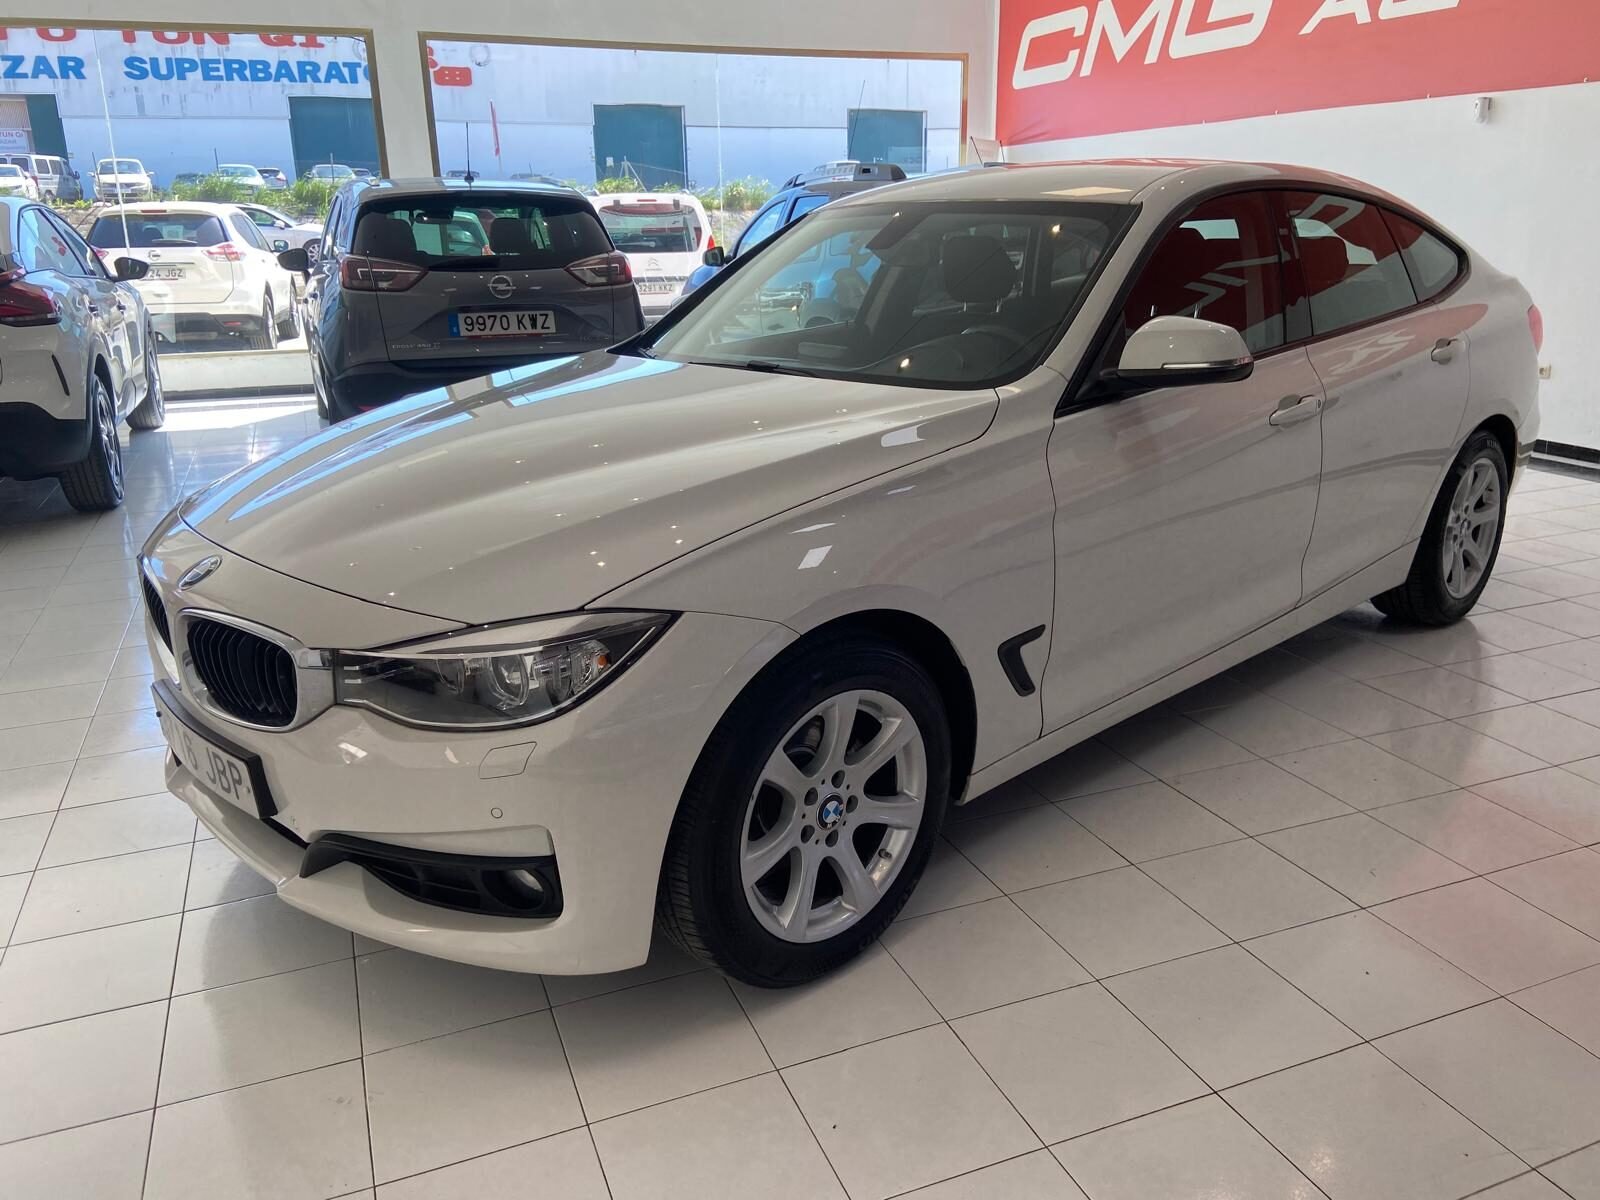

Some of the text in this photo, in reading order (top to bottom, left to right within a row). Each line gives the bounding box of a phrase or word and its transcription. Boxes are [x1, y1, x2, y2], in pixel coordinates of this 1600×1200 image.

[0, 54, 87, 80] ZAR
[149, 268, 161, 279] 24
[463, 313, 551, 333] 9970 KWZ
[205, 746, 243, 801] JBP
